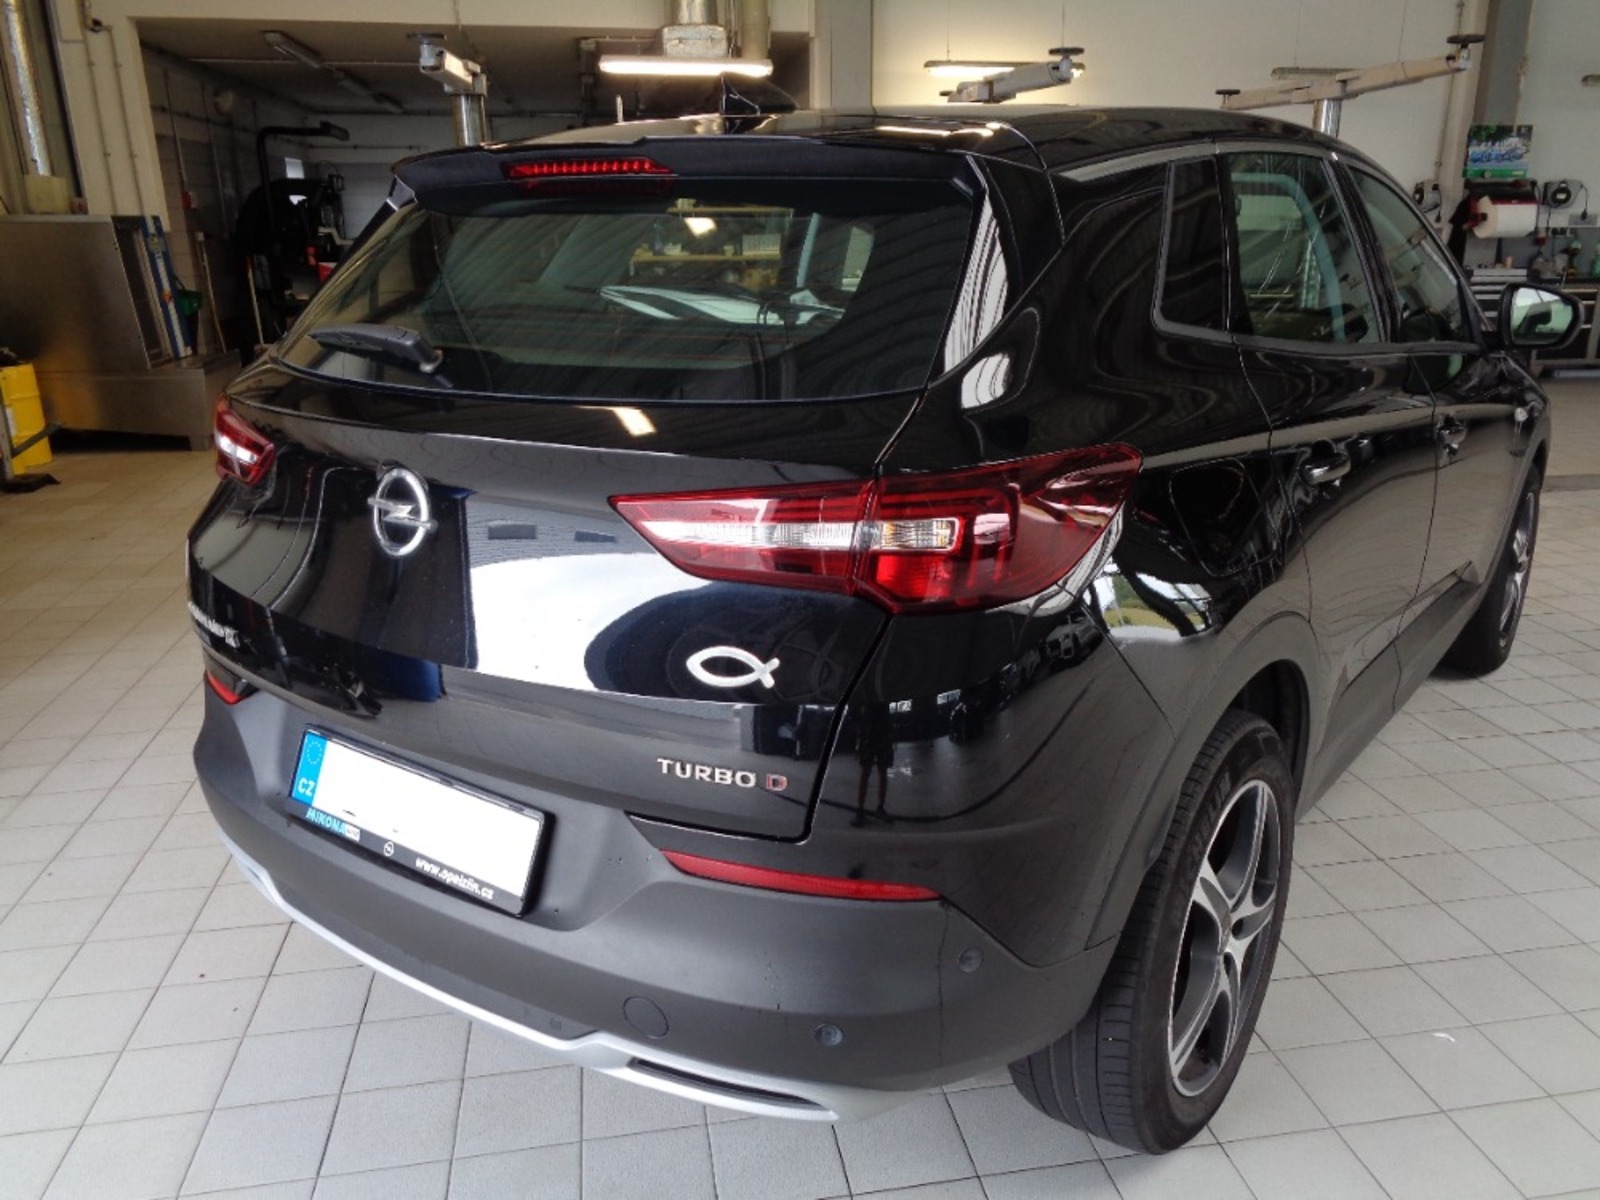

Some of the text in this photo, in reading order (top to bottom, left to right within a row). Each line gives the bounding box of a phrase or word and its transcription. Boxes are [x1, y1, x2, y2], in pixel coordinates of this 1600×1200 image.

[297, 777, 316, 797] CZ
[657, 758, 788, 791] TURBO D
